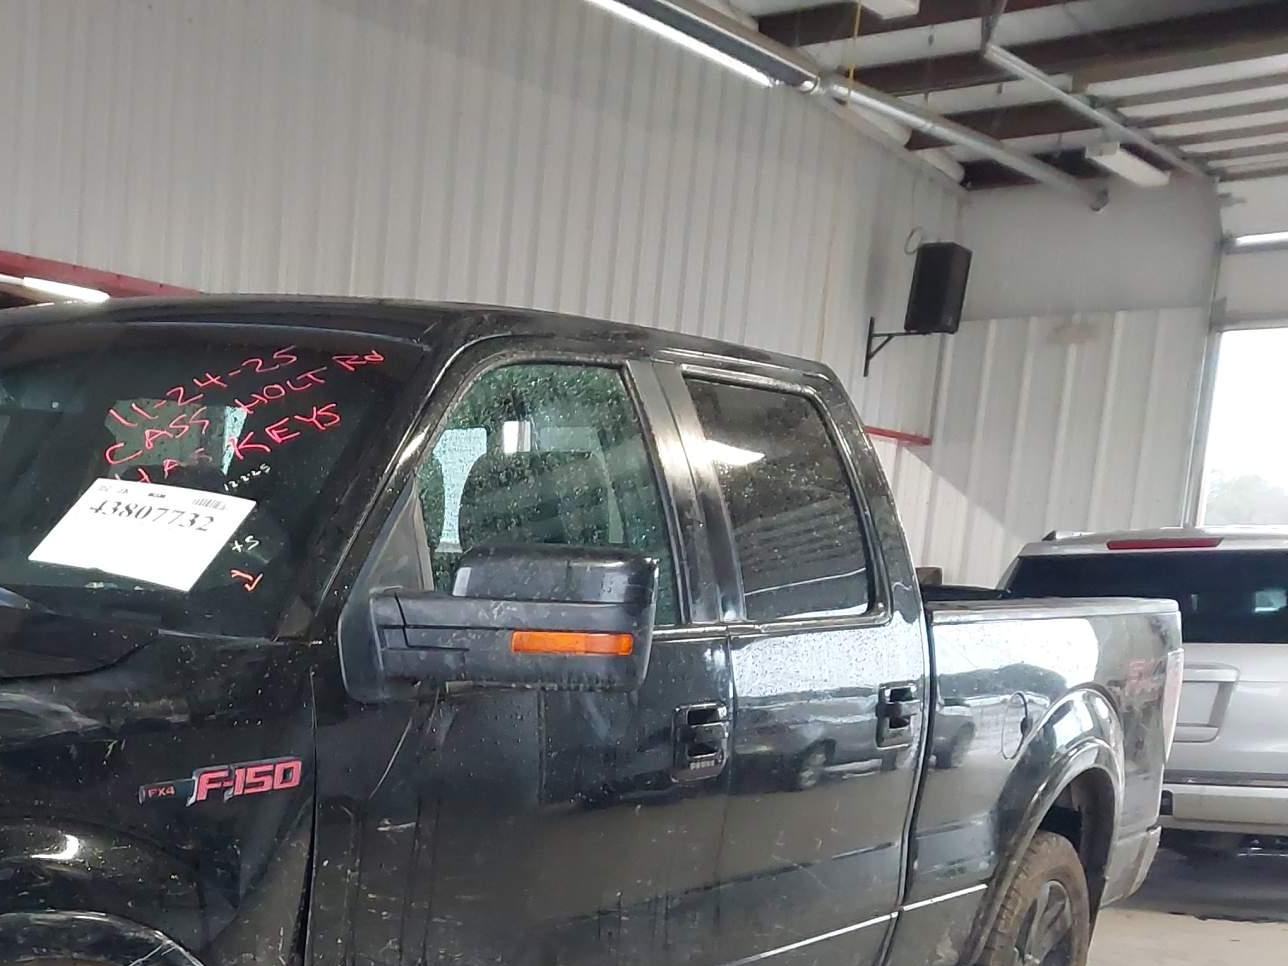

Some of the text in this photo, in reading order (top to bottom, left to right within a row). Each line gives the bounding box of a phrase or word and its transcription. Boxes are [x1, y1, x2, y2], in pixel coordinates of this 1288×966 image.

[109, 345, 297, 427] 11-24-25
[105, 406, 210, 465] CASS
[234, 366, 328, 415] HOLT
[228, 403, 341, 460] KEYS
[88, 500, 215, 532] 43807732
[148, 760, 302, 801] FX4 F-150
